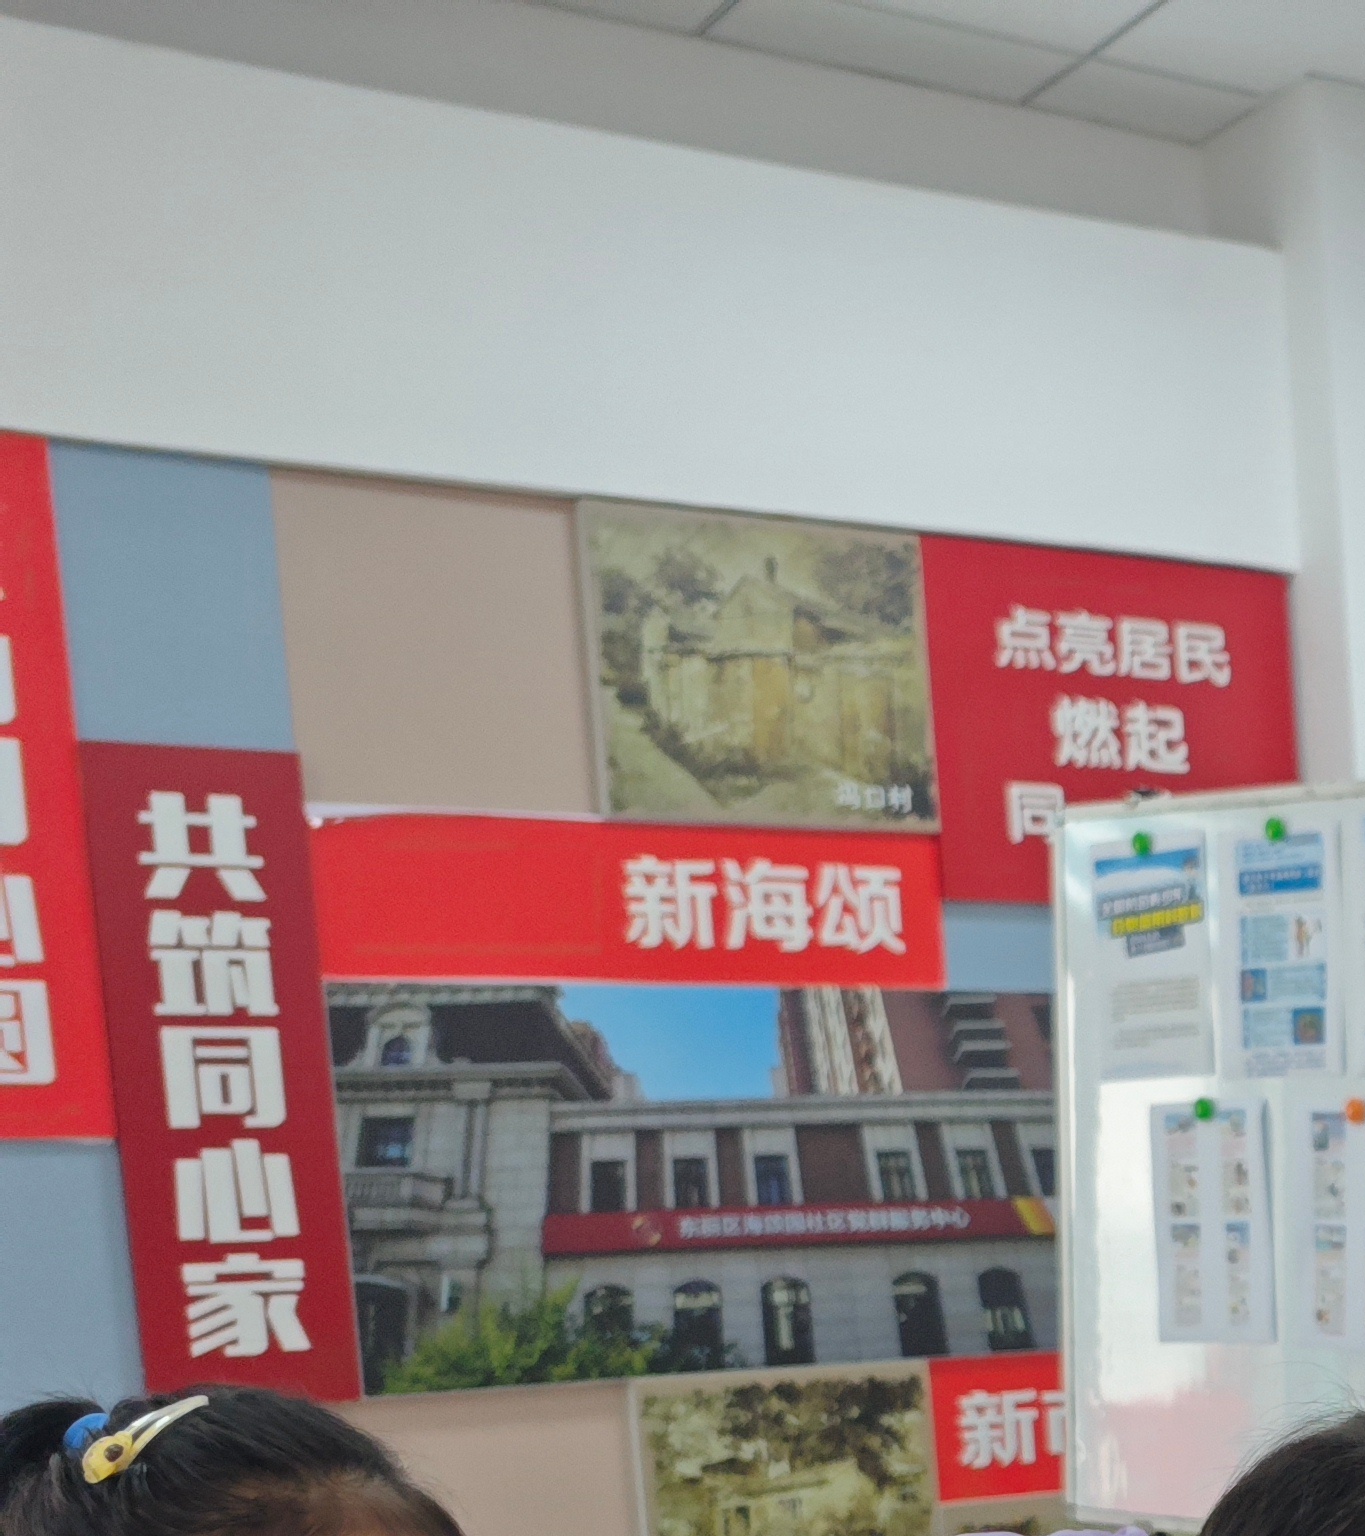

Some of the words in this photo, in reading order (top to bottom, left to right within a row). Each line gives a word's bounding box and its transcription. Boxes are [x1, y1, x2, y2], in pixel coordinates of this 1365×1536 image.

[995, 605, 1231, 688] 点亮居民
[1052, 696, 1191, 774] 燃起
[622, 855, 906, 954] 新海颂
[137, 790, 311, 1358] 共筑同心家
[957, 1388, 1065, 1470] 新
